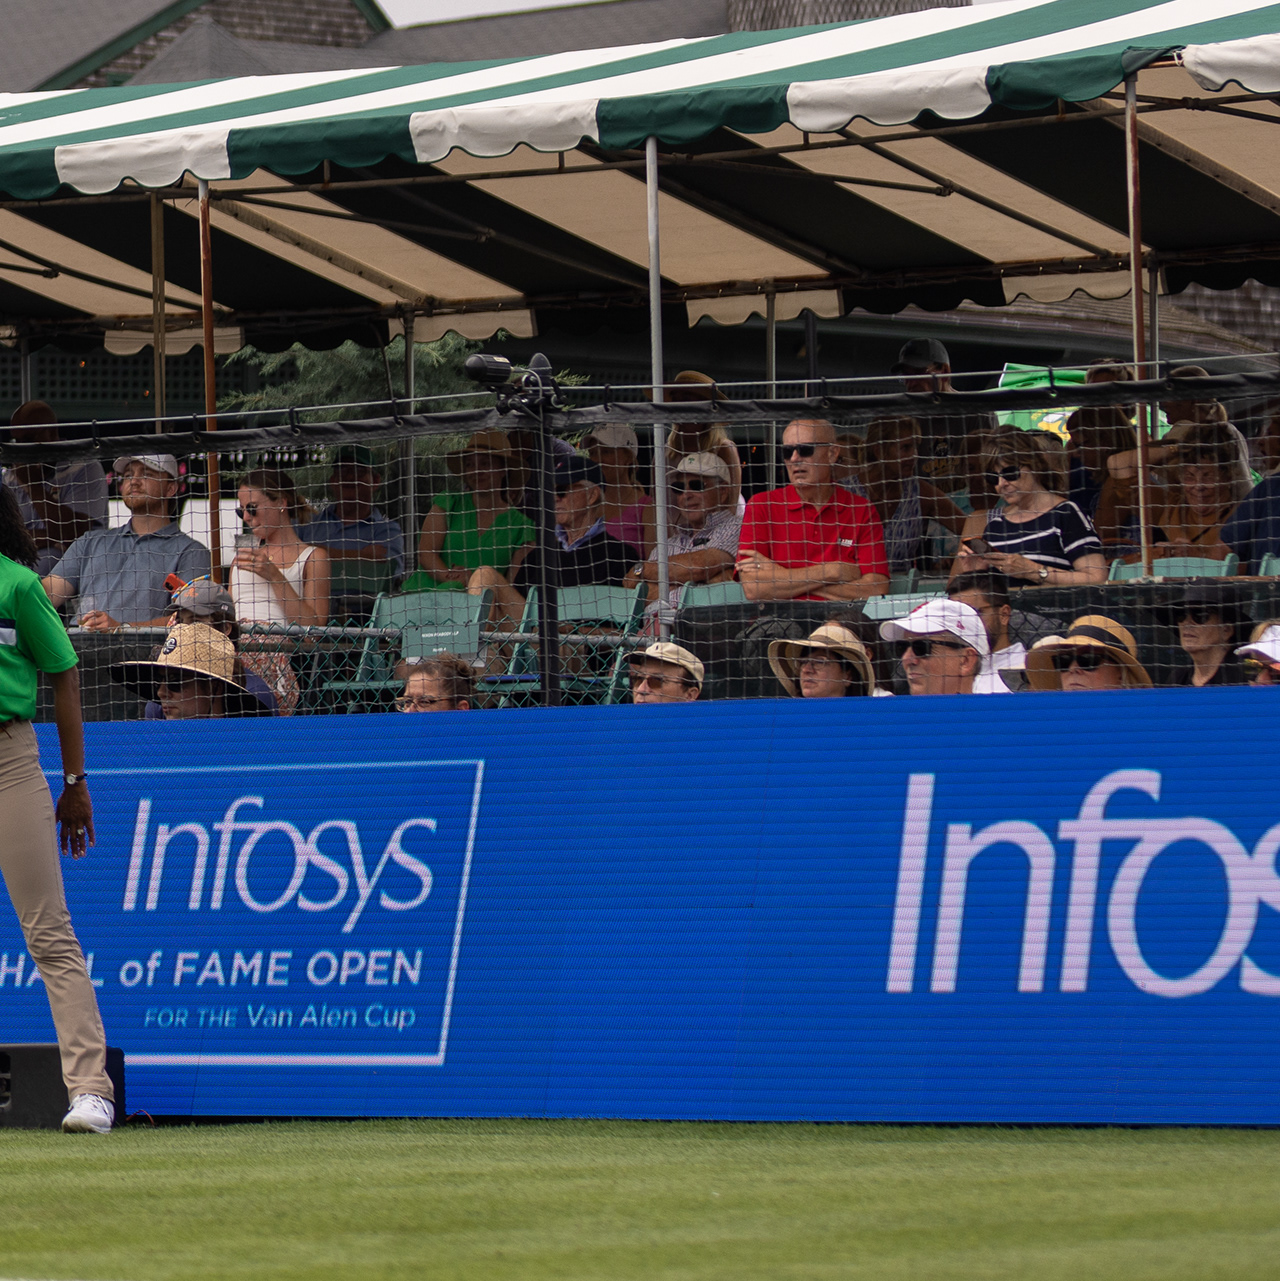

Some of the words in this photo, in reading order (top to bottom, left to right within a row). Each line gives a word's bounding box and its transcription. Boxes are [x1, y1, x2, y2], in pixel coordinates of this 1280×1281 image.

[123, 796, 437, 933] Infosys
[119, 949, 162, 987] of
[173, 949, 292, 986] FAME
[306, 948, 422, 985] OPEN
[144, 1007, 188, 1027] FOR
[197, 1007, 238, 1027] THE
[247, 1004, 293, 1027] Van
[299, 1003, 357, 1027] Alen
[364, 1004, 416, 1032] Cup
